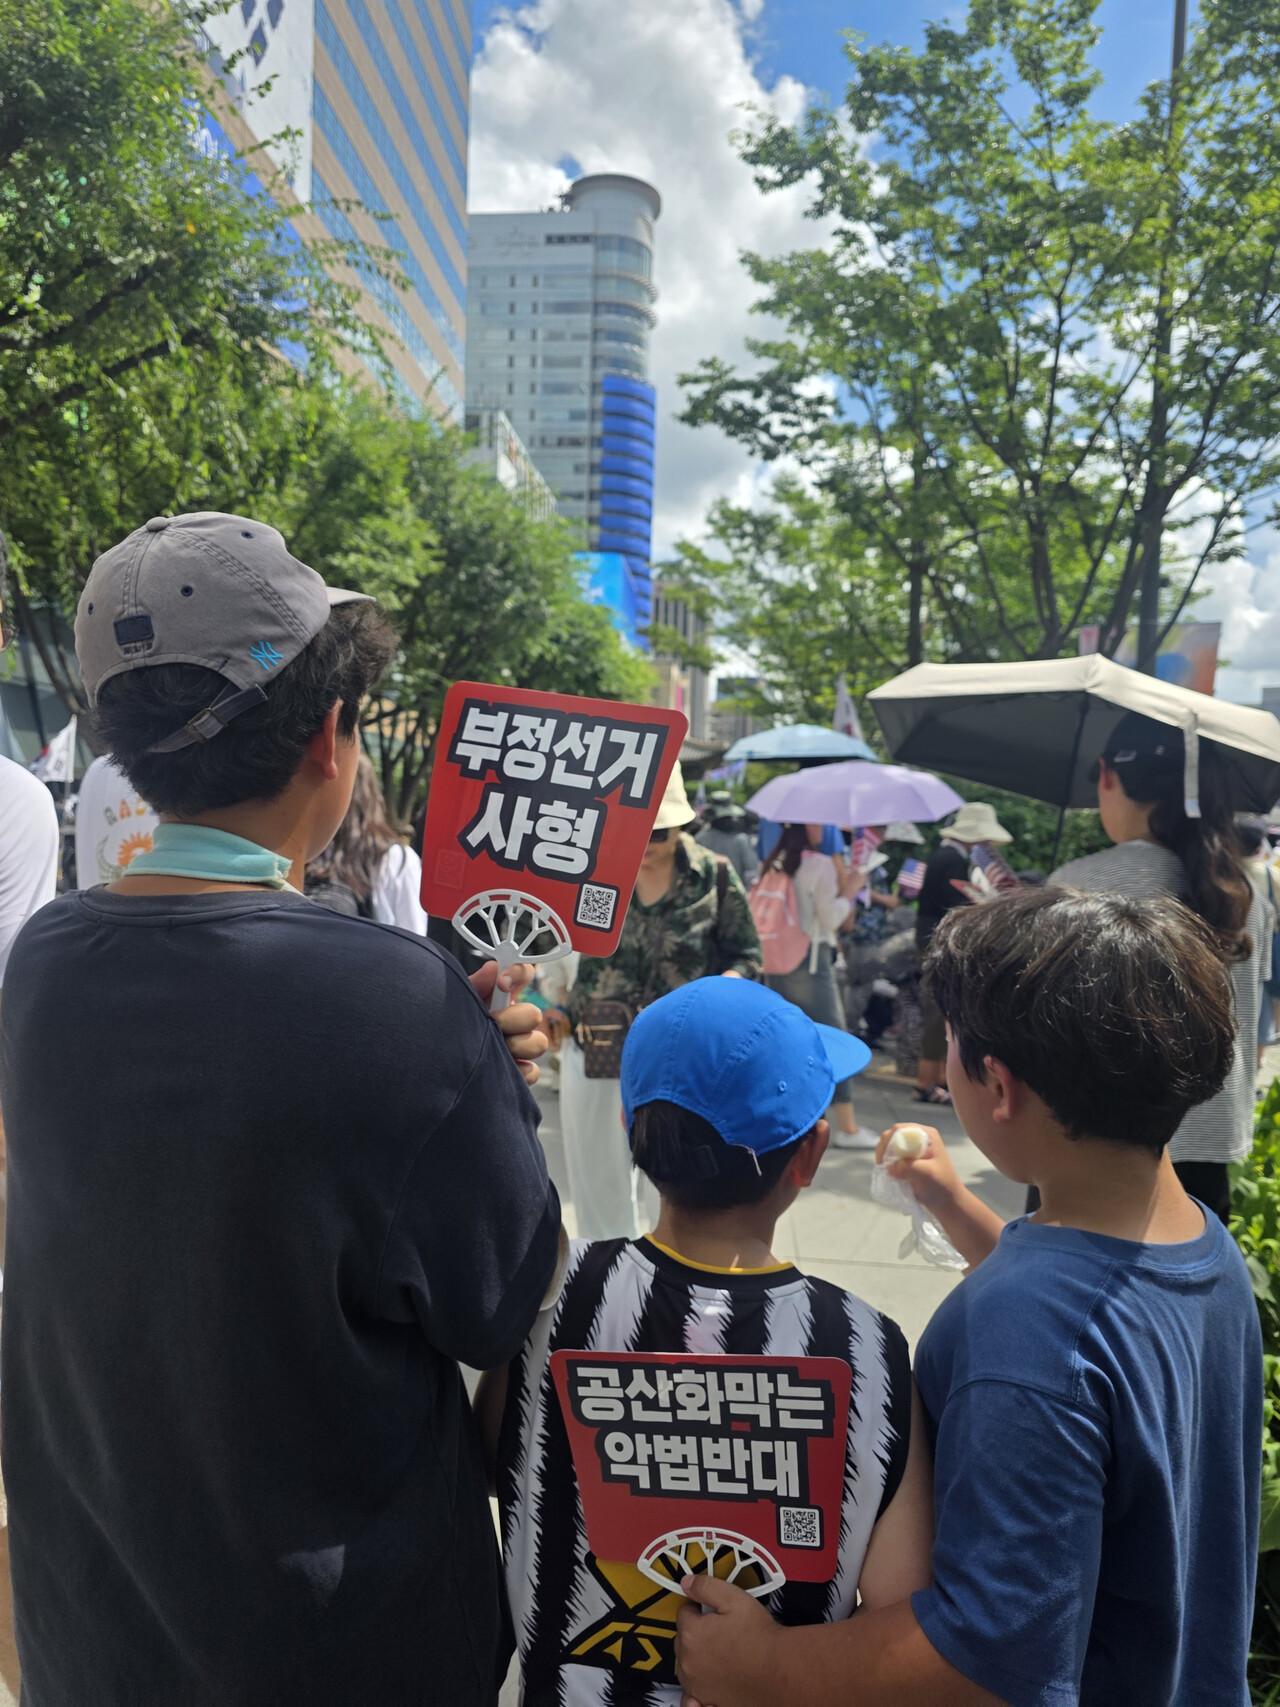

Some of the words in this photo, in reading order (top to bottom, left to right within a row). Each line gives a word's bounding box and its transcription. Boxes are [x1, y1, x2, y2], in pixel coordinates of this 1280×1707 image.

[455, 707, 659, 799] 부정선거
[466, 791, 600, 875] 사형
[576, 1366, 825, 1430] 공산화막는
[603, 1431, 800, 1498] 악법반대
